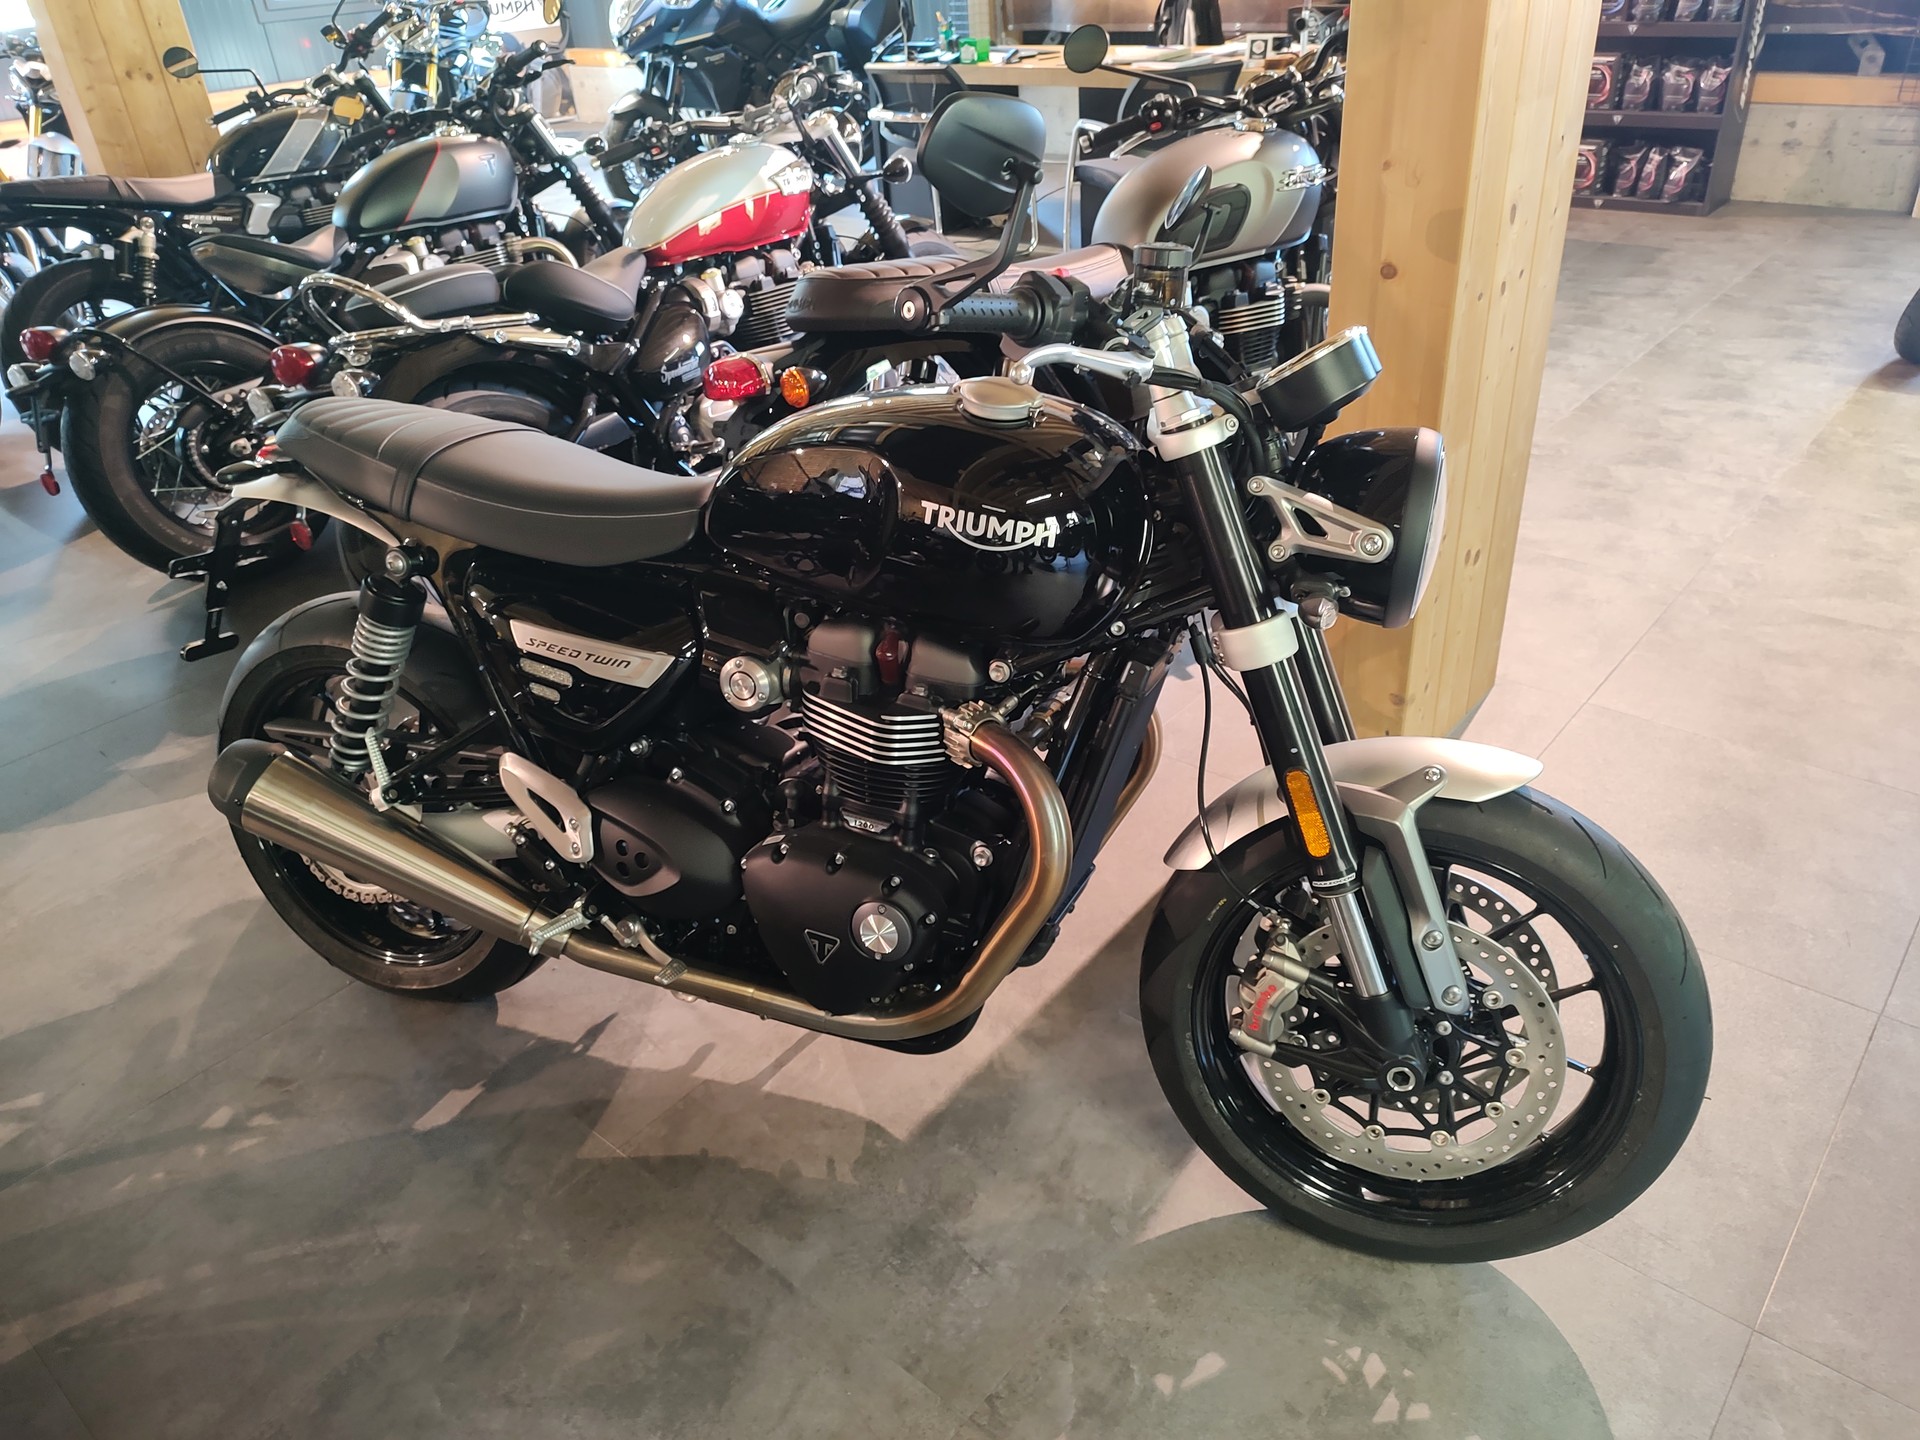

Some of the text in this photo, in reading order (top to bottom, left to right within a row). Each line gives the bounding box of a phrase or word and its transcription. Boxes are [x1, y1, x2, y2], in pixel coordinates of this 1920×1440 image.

[921, 500, 1058, 551] TRIUMPH
[526, 637, 632, 669] SPEED TWIN
[854, 819, 875, 830] 1200
[1248, 984, 1277, 1031] brembo
